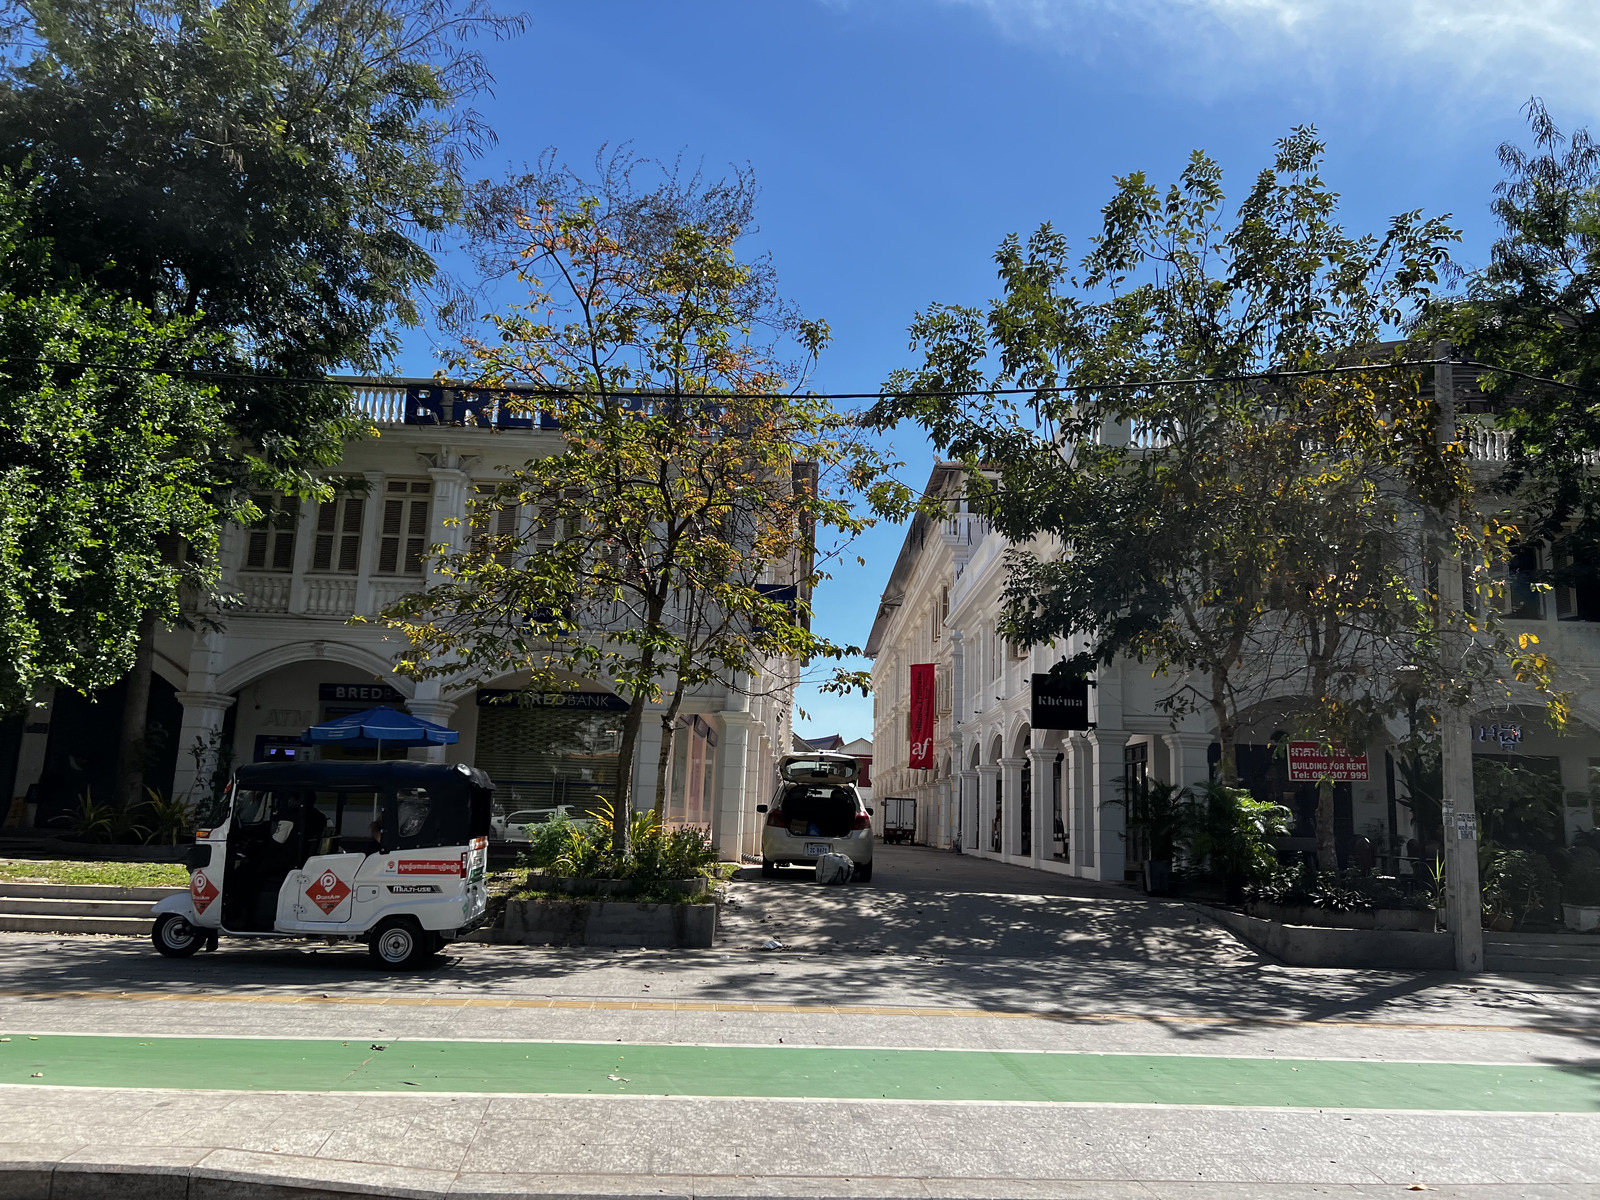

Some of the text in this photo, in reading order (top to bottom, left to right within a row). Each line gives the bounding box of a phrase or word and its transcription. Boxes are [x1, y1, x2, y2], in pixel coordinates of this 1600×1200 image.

[262, 709, 316, 727] ATM
[911, 737, 932, 760] af
[1292, 762, 1328, 770] BUILDING
[1346, 762, 1367, 771] RENT
[1293, 771, 1310, 779] Tel:
[1332, 771, 1348, 779] 307
[1350, 771, 1367, 780] 999
